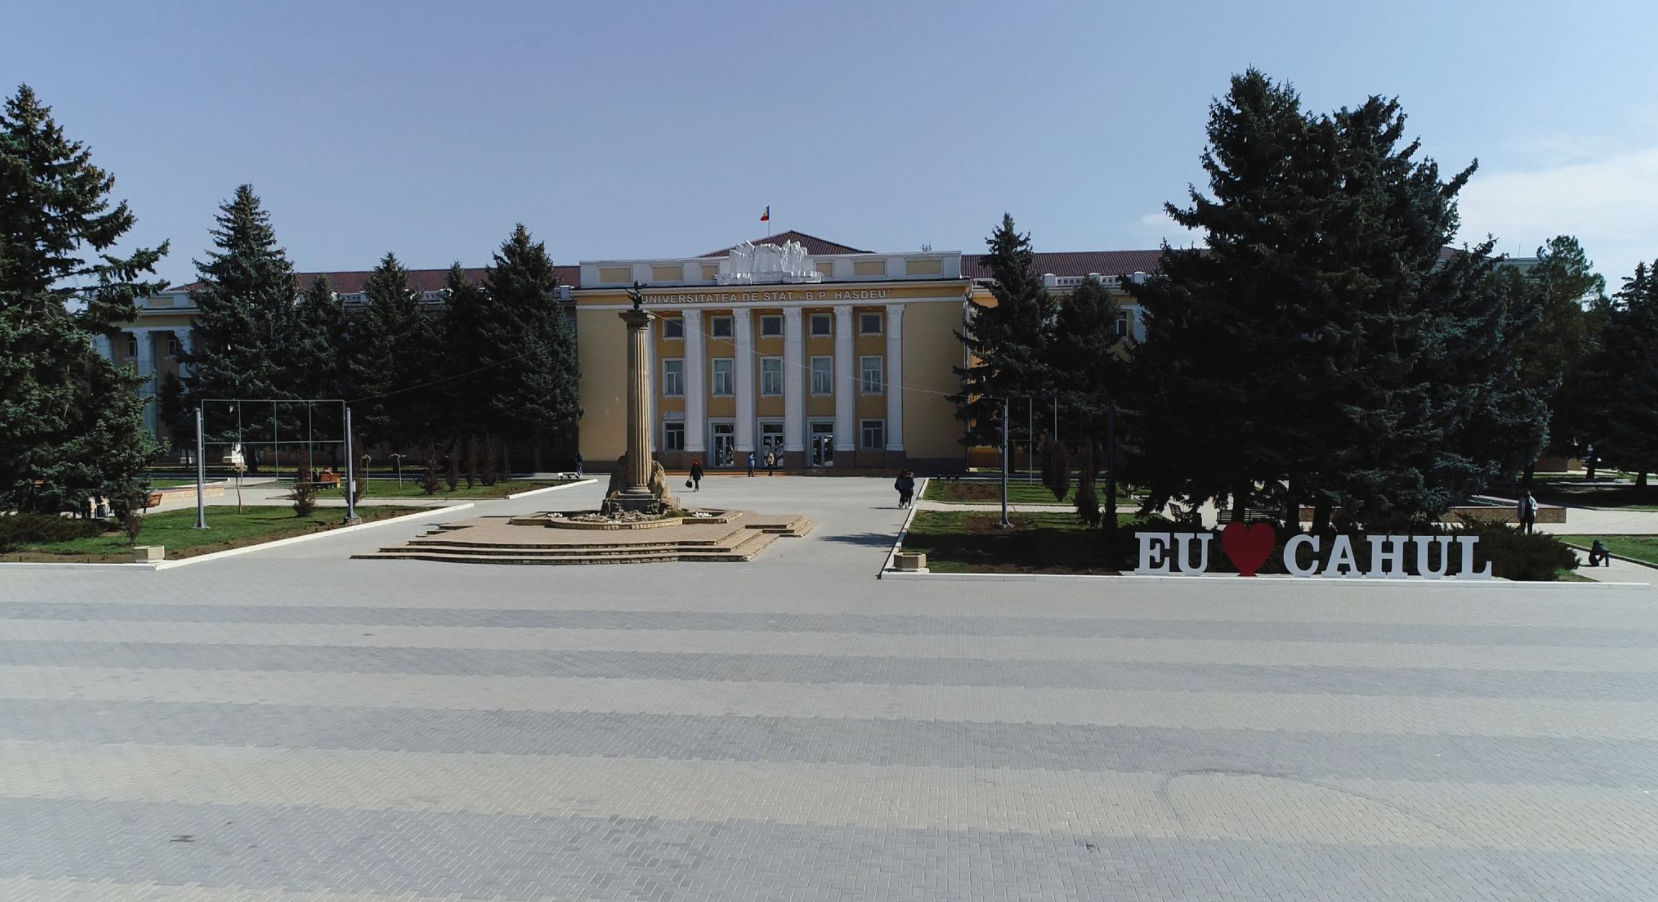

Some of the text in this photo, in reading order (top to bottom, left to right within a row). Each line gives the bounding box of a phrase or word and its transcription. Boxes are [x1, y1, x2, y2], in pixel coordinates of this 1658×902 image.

[642, 293, 737, 304] UNIVERSITATEA
[743, 292, 758, 301] DE
[763, 291, 794, 301] STAT
[1134, 531, 1493, 579] EU CAHUL
